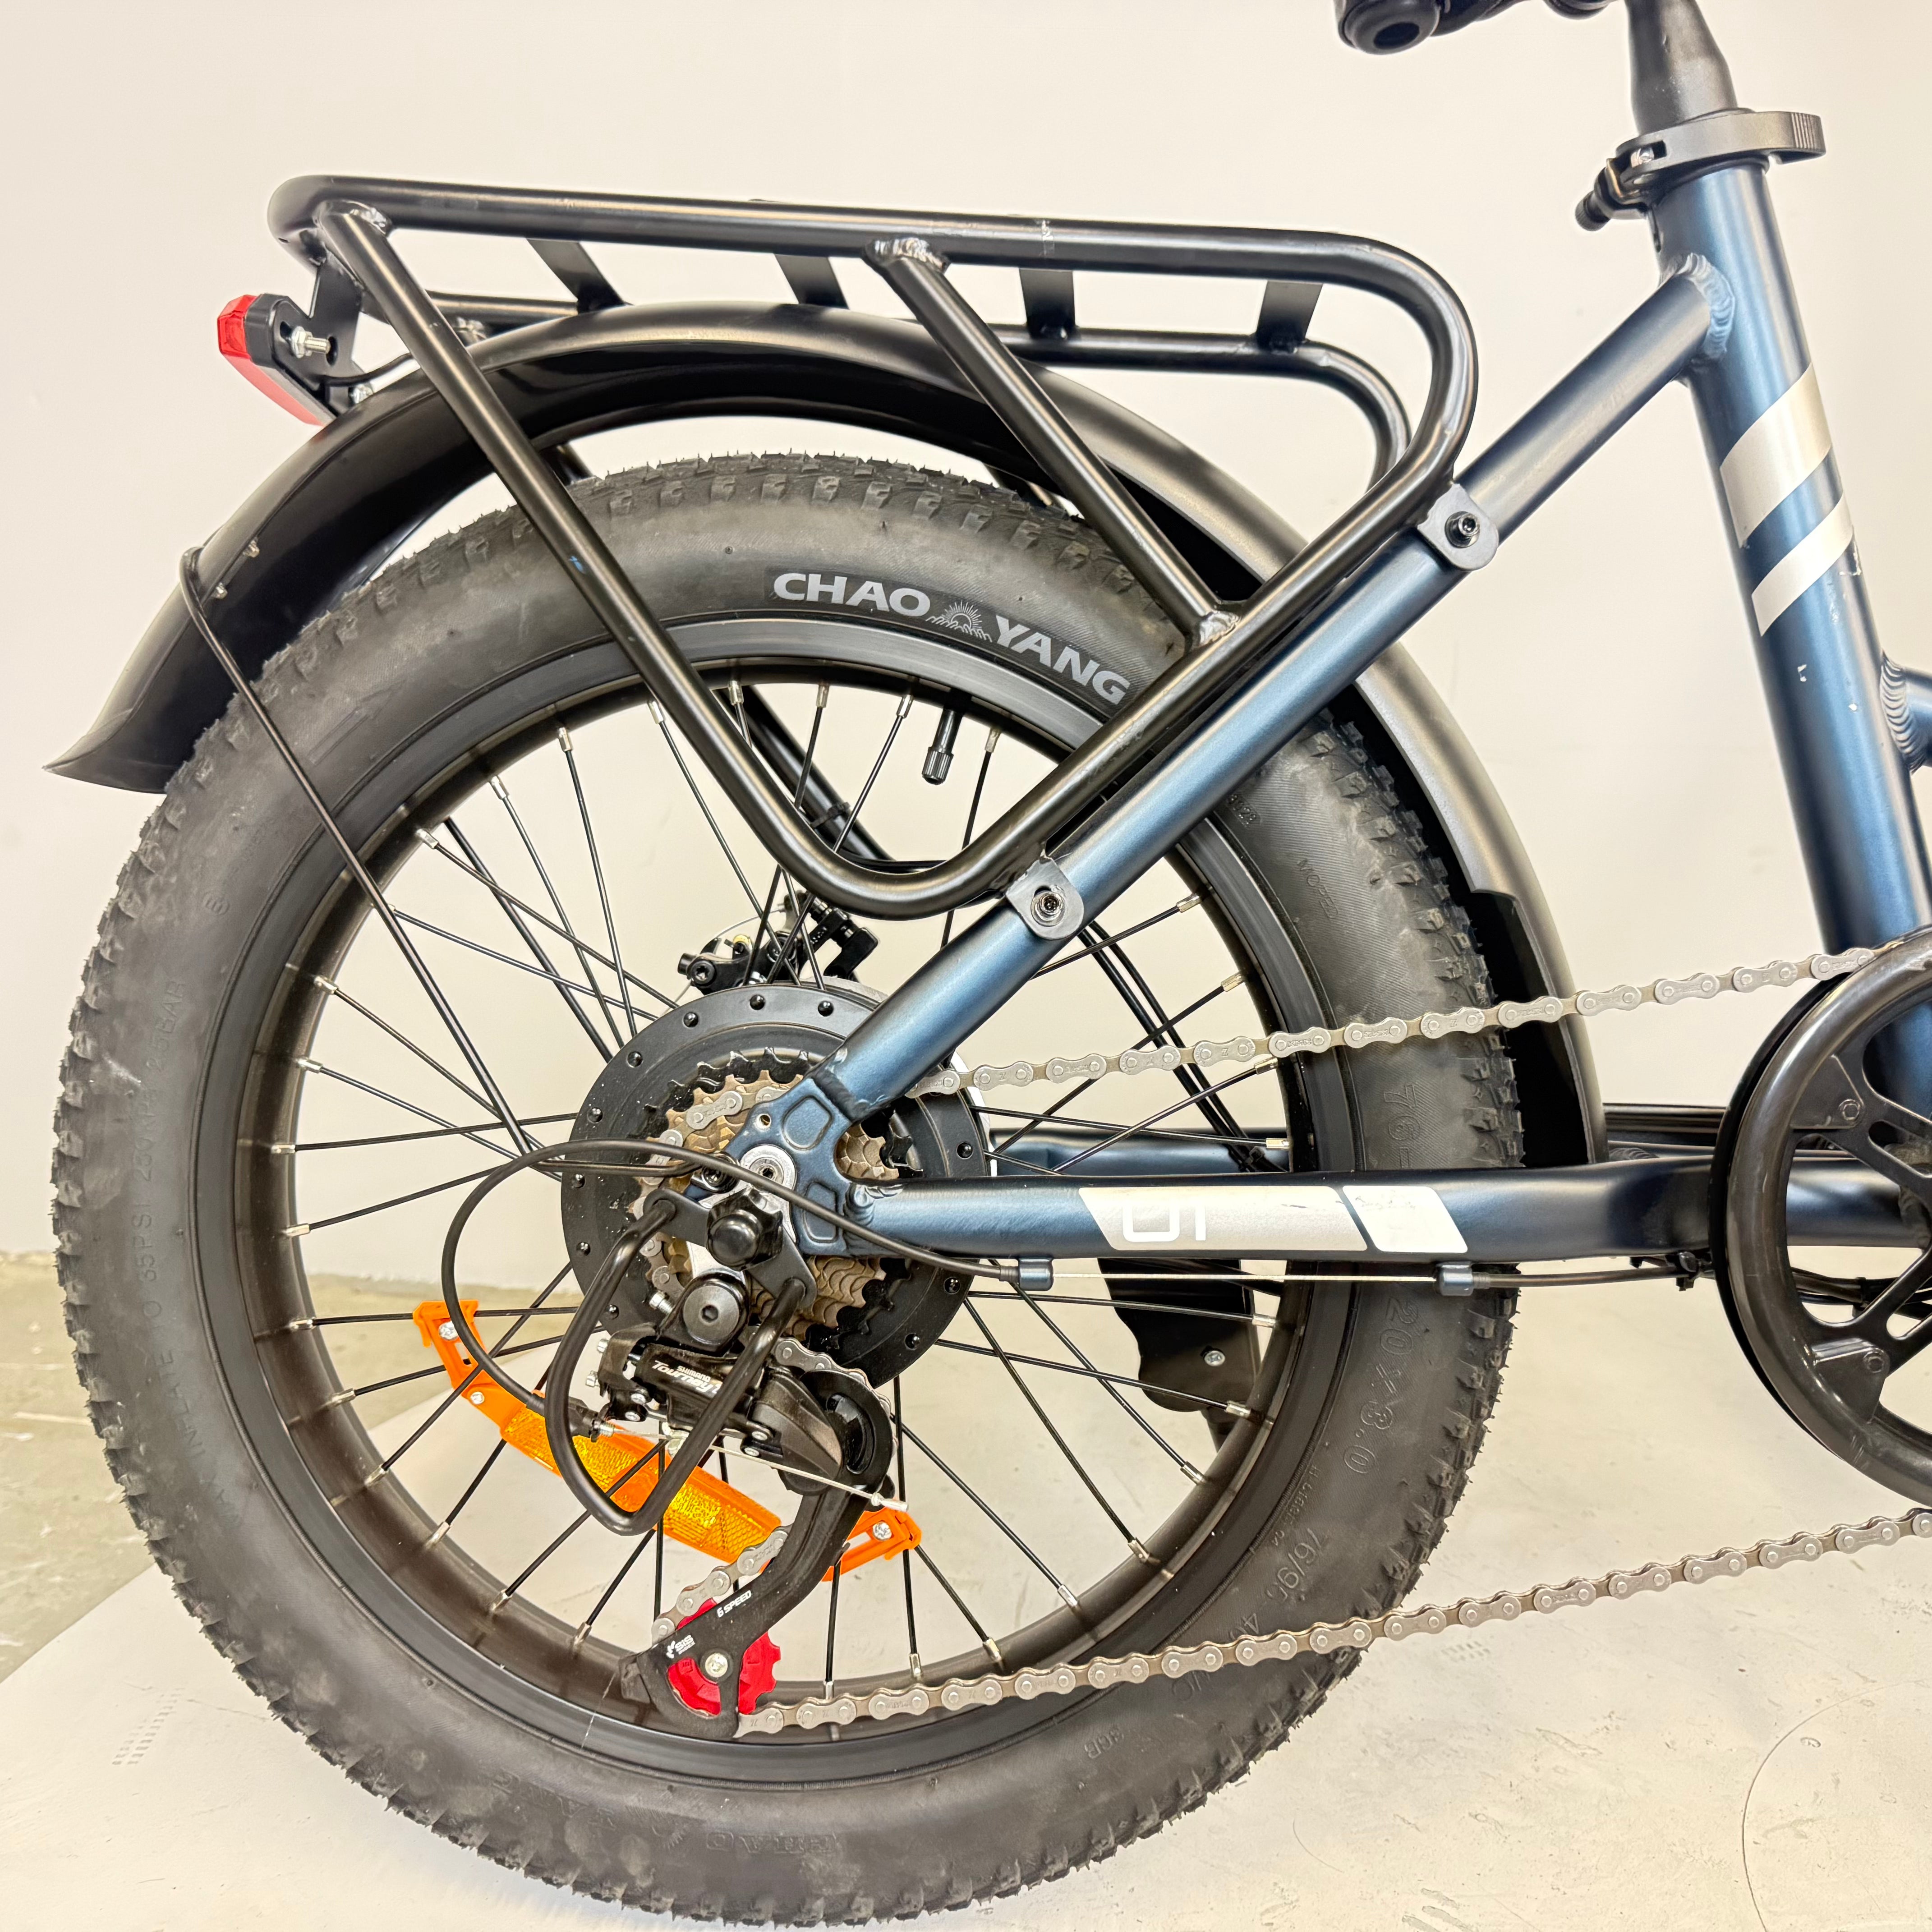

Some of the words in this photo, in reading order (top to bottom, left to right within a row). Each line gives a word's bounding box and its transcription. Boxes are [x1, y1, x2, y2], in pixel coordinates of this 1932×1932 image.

[773, 573, 931, 617] CHAO
[994, 614, 1131, 705] YANG
[1287, 1037, 1312, 1048] KMC
[651, 1360, 714, 1393] Tourney
[676, 1365, 712, 1383] SHIMANO
[716, 1606, 725, 1618] 6
[723, 1590, 752, 1614] SPEED
[674, 1634, 695, 1650] SIS
